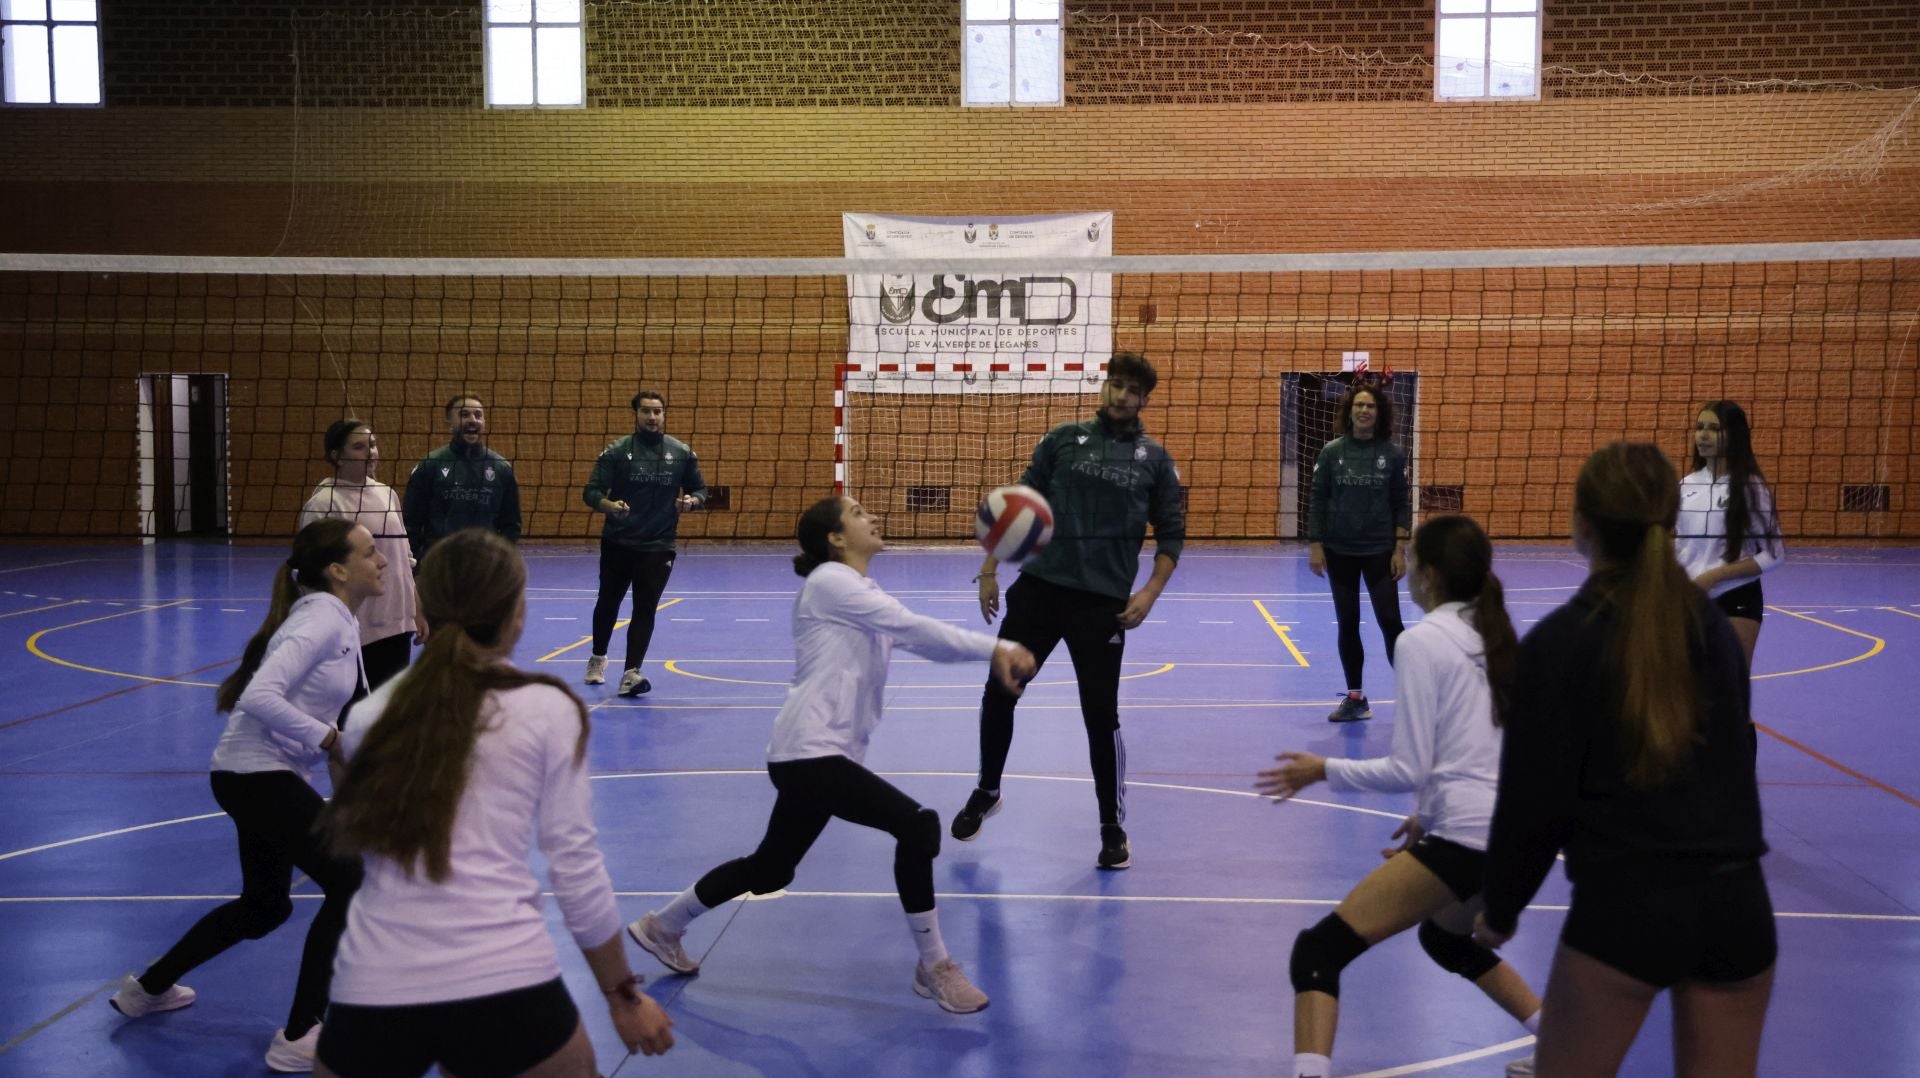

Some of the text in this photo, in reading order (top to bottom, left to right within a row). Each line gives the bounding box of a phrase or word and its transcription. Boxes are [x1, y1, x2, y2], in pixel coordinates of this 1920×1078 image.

[875, 328, 1077, 336] ESCUELA MUNICIPAL DE DEPORTES
[908, 341, 921, 349] DE
[924, 340, 976, 349] VALVERDE
[979, 340, 992, 349] DE
